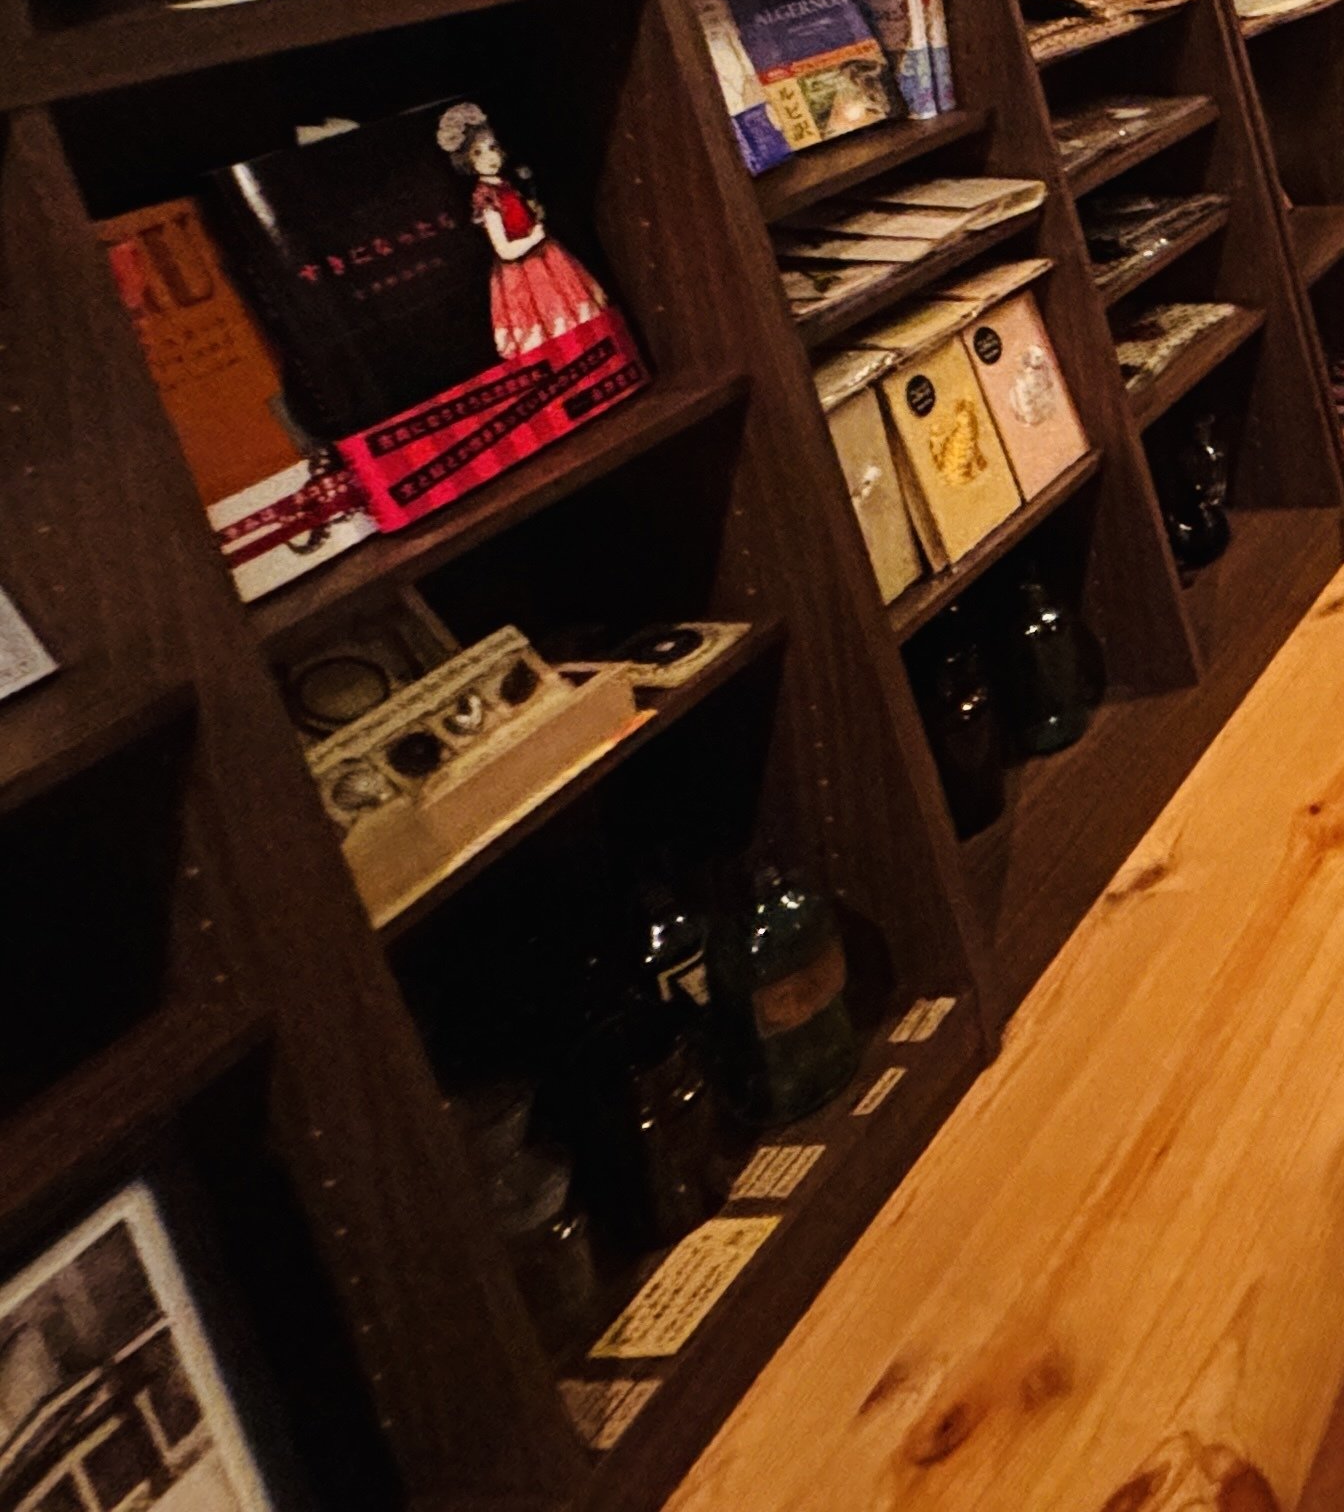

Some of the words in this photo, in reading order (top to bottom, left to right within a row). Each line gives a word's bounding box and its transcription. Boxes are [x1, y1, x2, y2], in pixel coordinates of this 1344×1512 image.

[777, 86, 816, 141] ルビ訳
[298, 211, 457, 283] すきになったら
